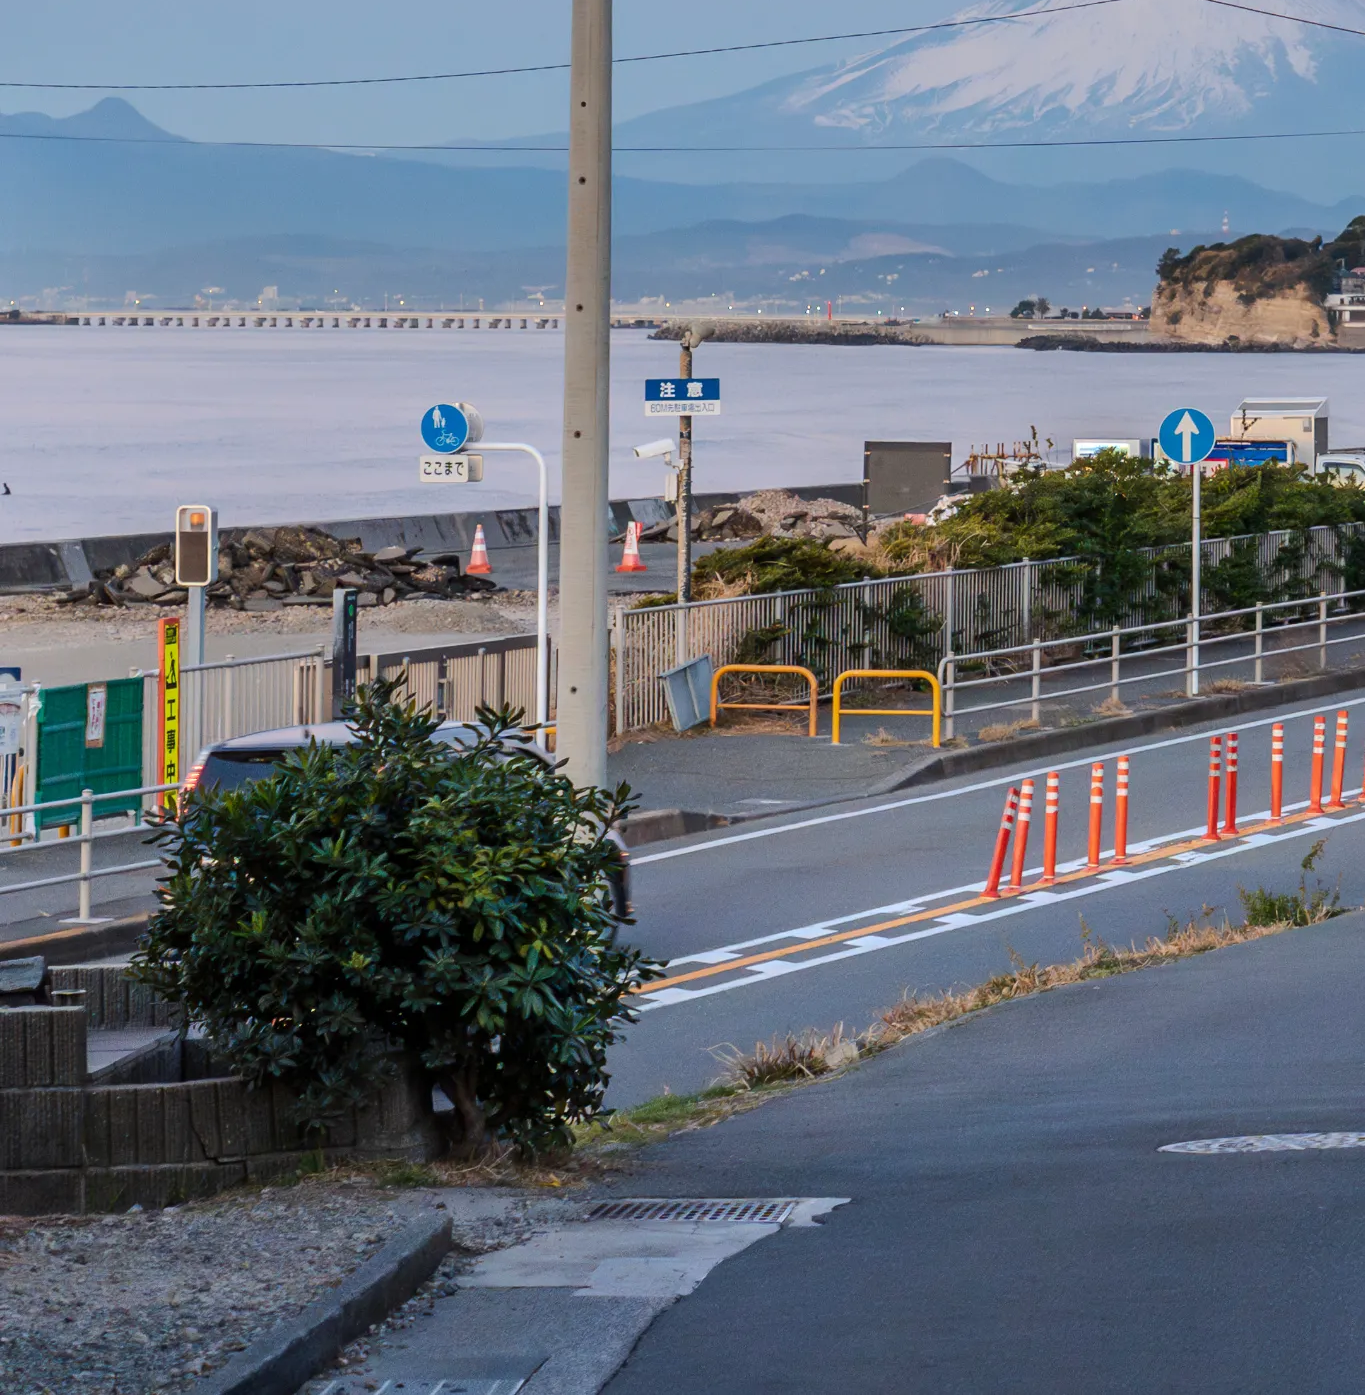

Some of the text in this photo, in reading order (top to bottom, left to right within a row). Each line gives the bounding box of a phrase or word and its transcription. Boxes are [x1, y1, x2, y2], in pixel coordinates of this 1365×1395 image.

[660, 382, 703, 398] 注意
[423, 461, 464, 476] ここまで
[166, 699, 176, 784] 工事中
